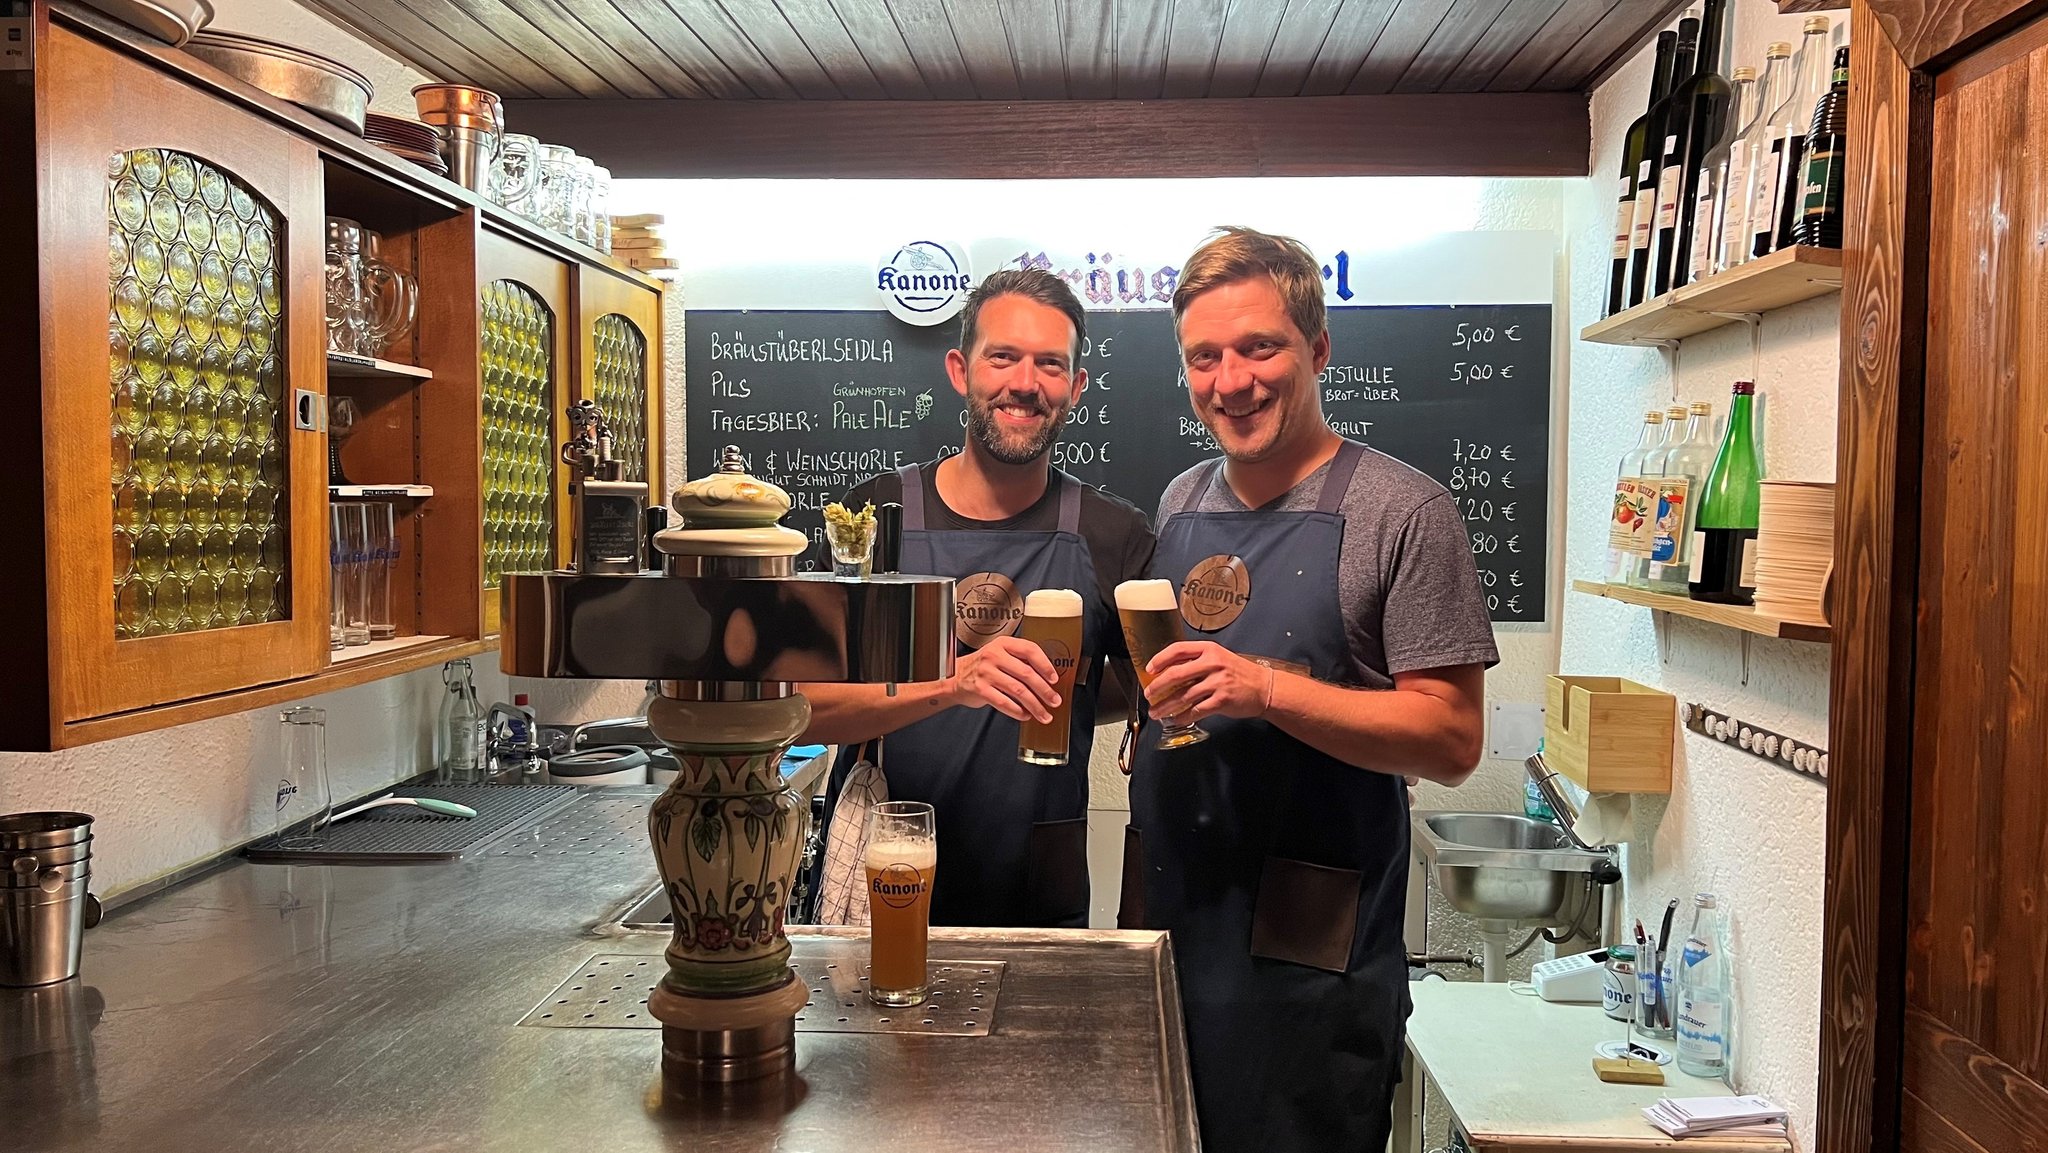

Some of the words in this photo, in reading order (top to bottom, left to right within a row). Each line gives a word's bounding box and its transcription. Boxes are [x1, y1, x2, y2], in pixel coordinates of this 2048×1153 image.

[877, 266, 972, 293] Kanone
[1452, 323, 1495, 351] 5,00
[1505, 325, 1522, 341] €
[711, 371, 751, 398] PILS
[1318, 367, 1394, 385] OTSTULLE
[1450, 363, 1493, 385] 5,00
[1500, 365, 1514, 379] €
[833, 381, 906, 397] GRÜNHOPFEN
[711, 410, 819, 433] TAGESBIER:
[833, 400, 870, 430] PALE
[874, 399, 912, 430] ALE
[786, 448, 903, 471] WEINSCHORLE
[1053, 442, 1094, 472] 5,00
[1453, 439, 1491, 465] 7,20
[1500, 445, 1516, 461] €
[1450, 466, 1490, 491] 8,70
[1501, 471, 1515, 489] €
[1501, 502, 1517, 521] €
[1472, 532, 1498, 553] 80
[1507, 535, 1521, 553] €
[1510, 570, 1523, 587] €
[1184, 578, 1245, 606] Kanone
[956, 602, 1021, 620] Kanone
[1507, 595, 1522, 613] €
[872, 877, 927, 896] Kanone
